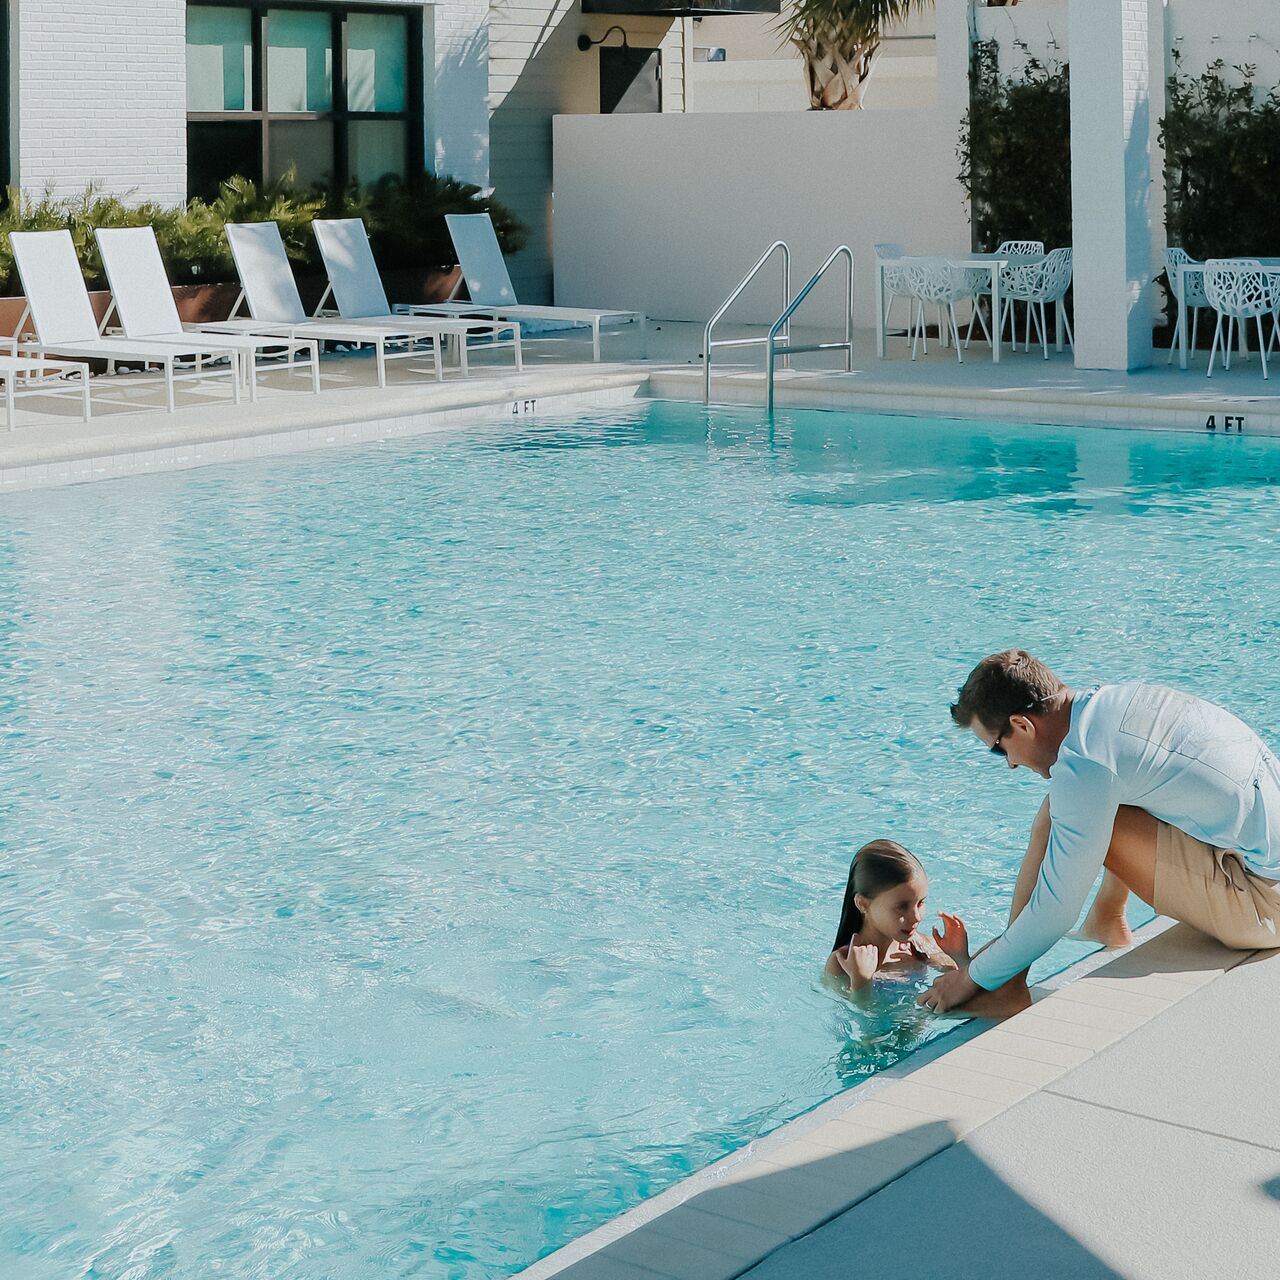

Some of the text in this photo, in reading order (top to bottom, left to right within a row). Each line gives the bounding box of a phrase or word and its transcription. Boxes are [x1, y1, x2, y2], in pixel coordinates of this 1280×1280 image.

[512, 399, 537, 415] 4 FT
[1206, 414, 1245, 433] 4 FT
